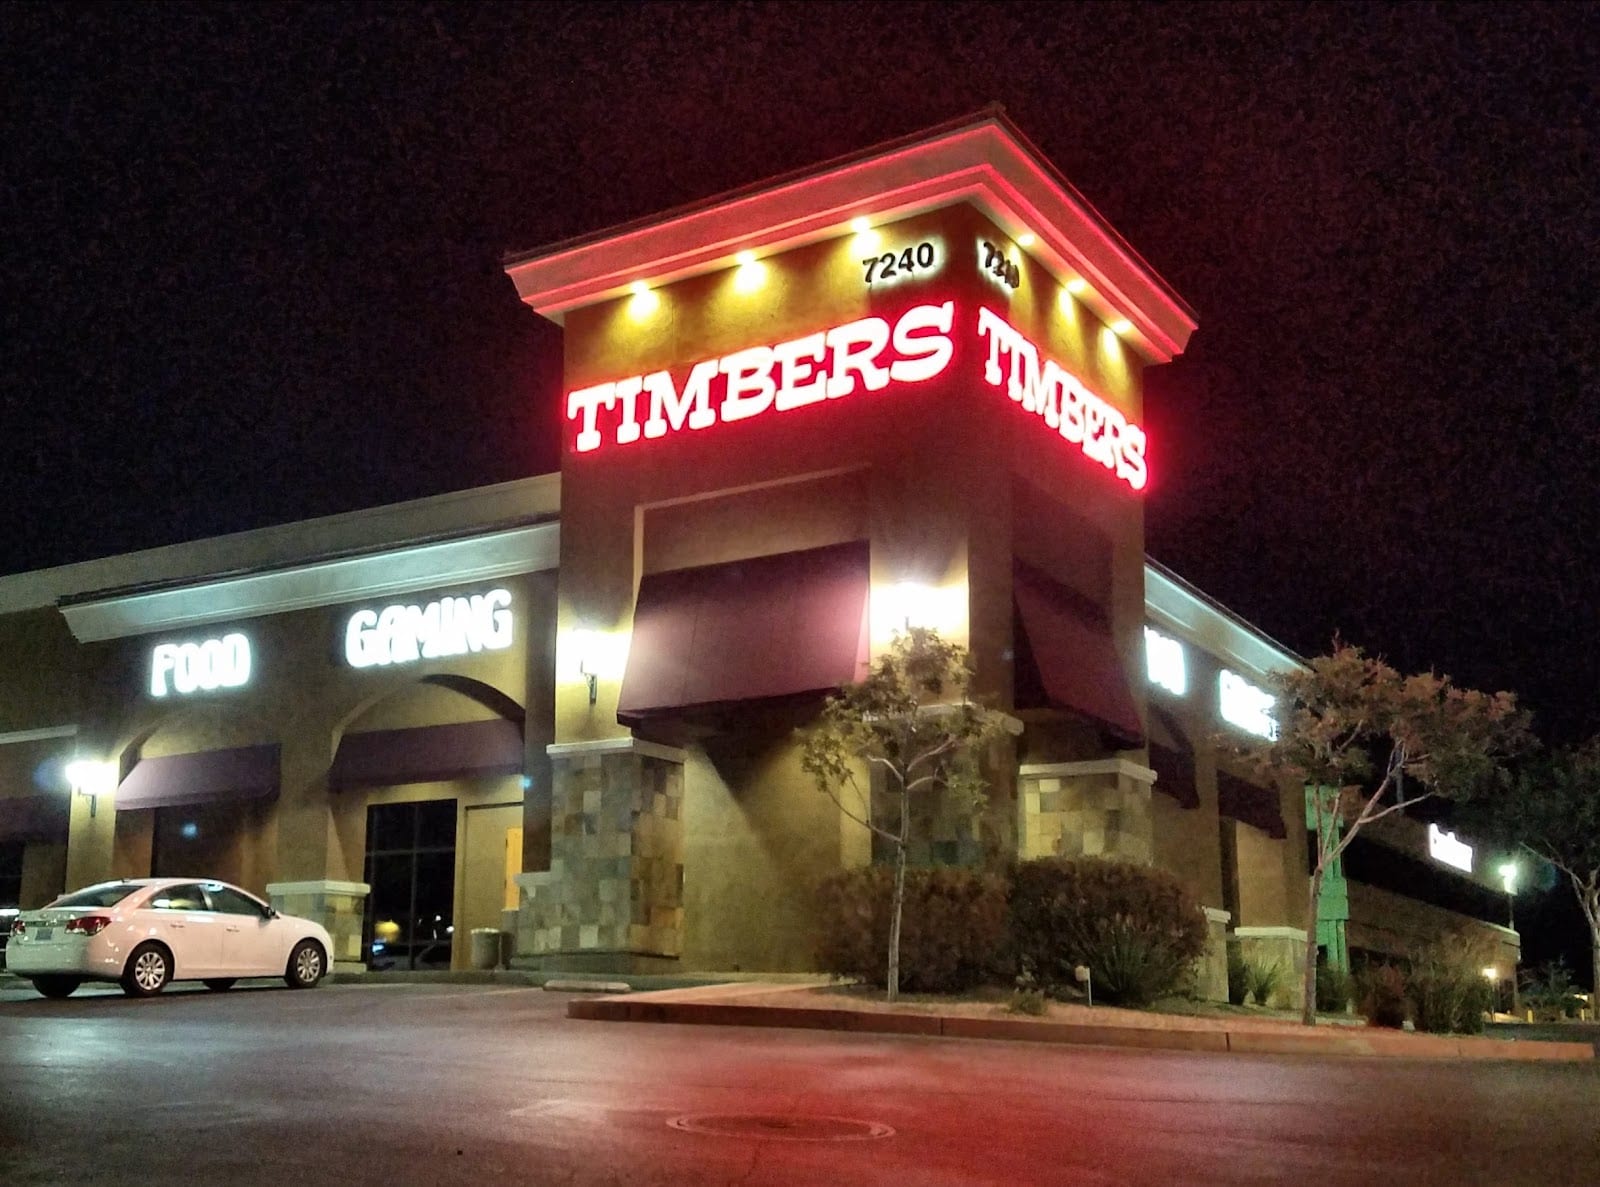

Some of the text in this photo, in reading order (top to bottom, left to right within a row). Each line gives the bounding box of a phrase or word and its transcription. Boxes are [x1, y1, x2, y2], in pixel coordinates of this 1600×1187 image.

[862, 242, 935, 283] 7240
[567, 301, 955, 452] TIMBERS
[978, 306, 1147, 489] TIMBERS
[151, 633, 251, 697] FOOD
[345, 589, 513, 668] GAMING
